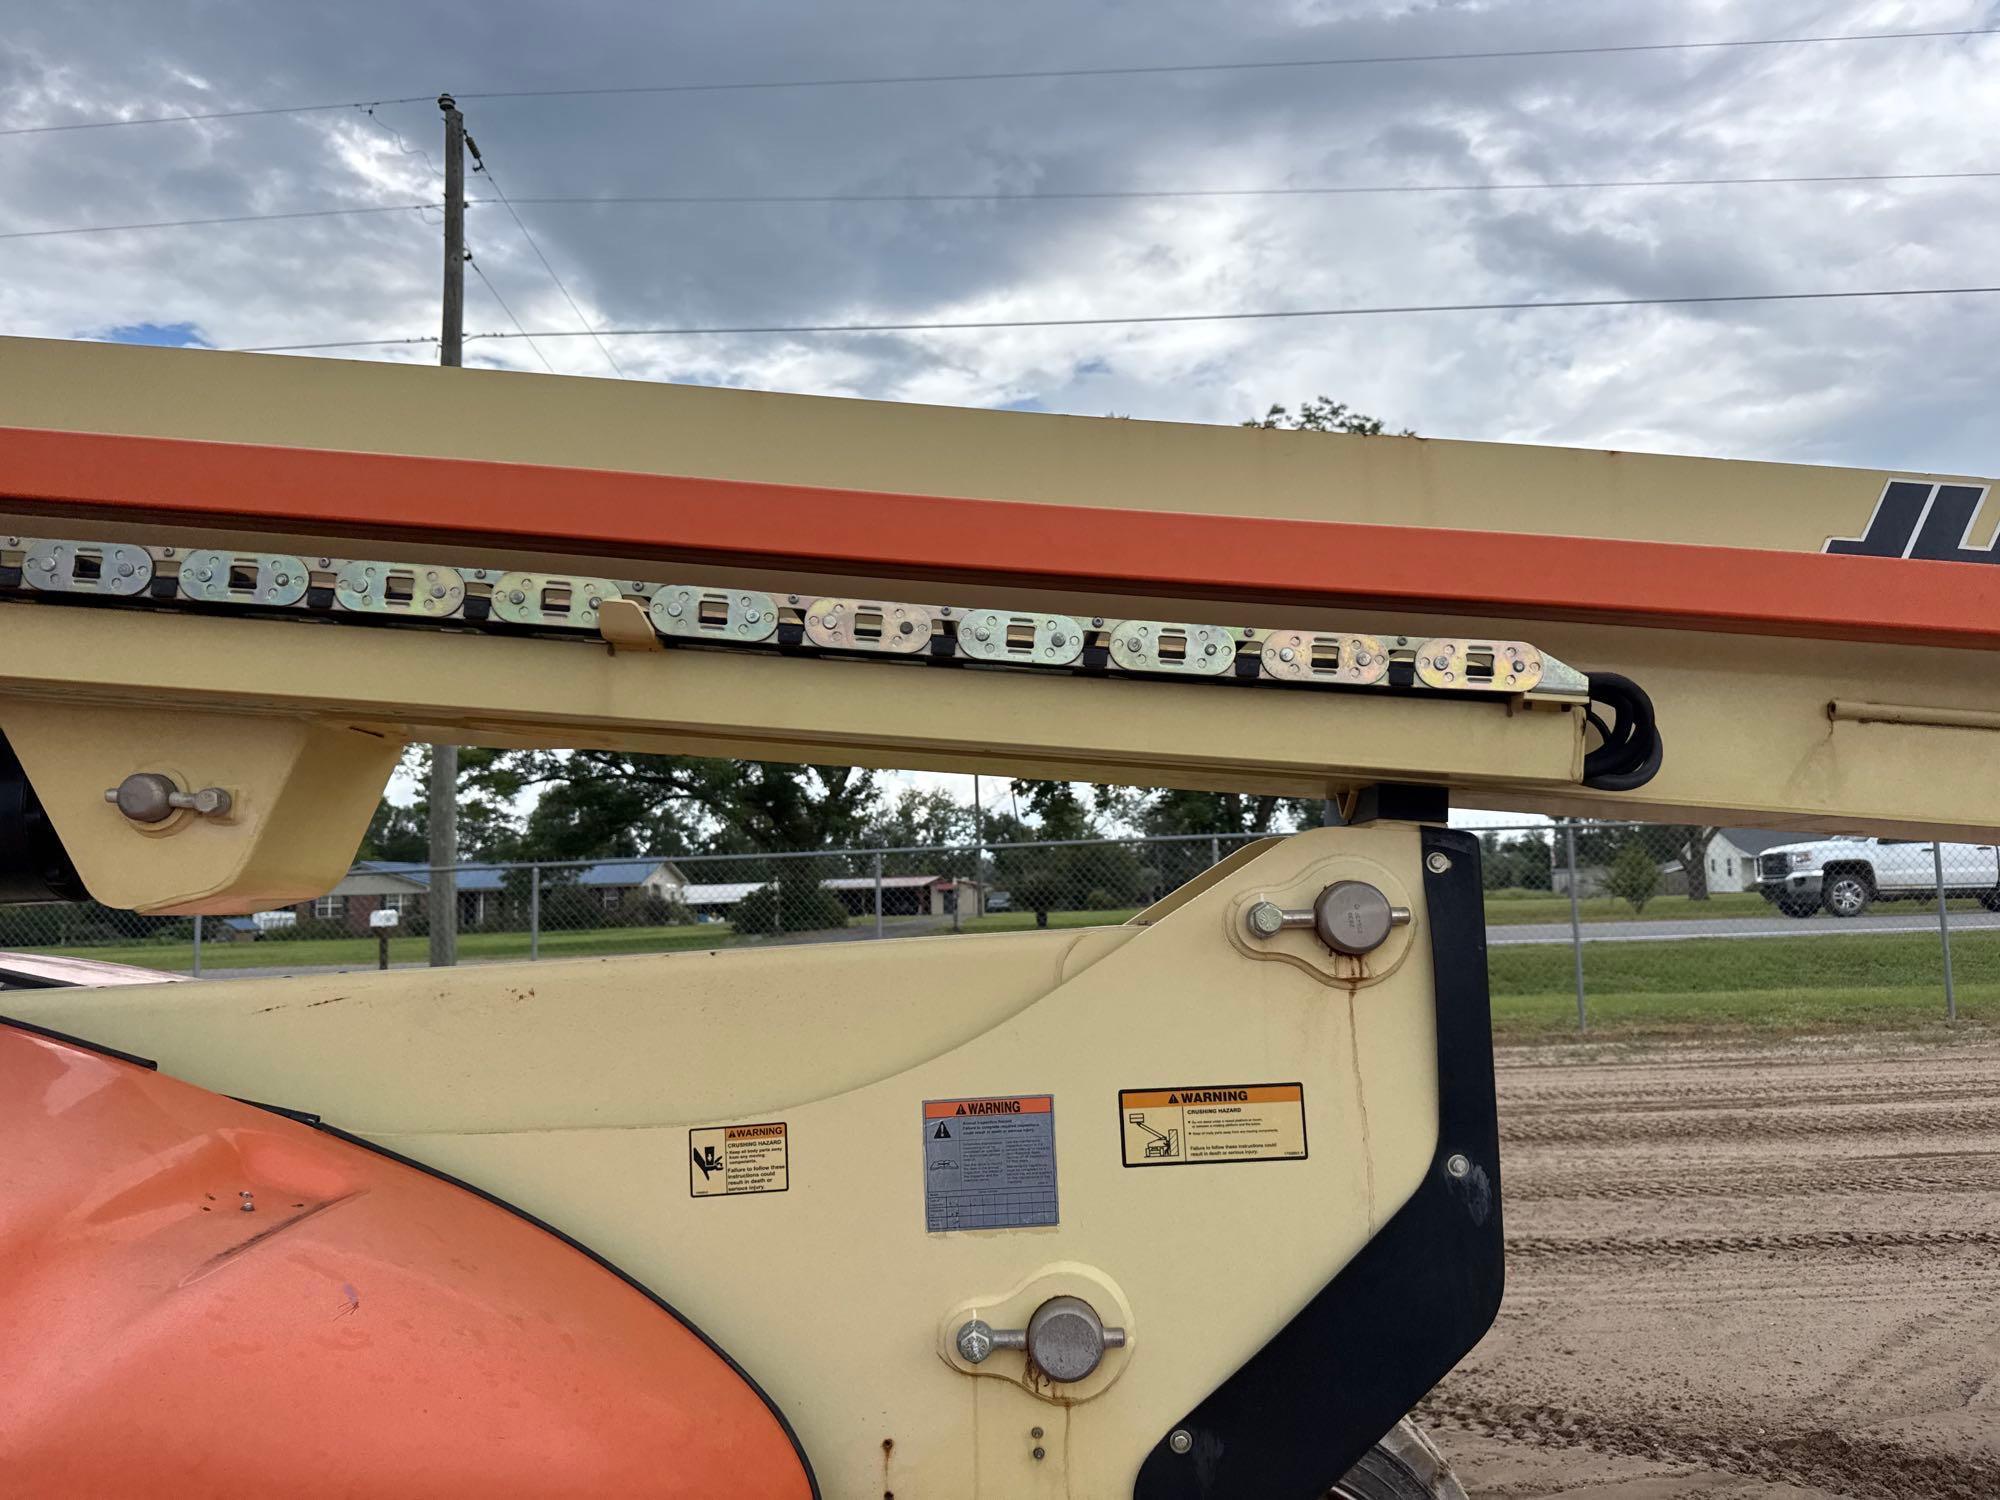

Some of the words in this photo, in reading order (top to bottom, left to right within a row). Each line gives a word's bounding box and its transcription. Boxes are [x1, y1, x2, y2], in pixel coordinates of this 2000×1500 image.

[1820, 477, 2000, 563] JL
[1180, 1090, 1248, 1103] WARNING
[968, 1101, 1020, 1114] WARNING
[736, 1127, 782, 1137] WARNING
